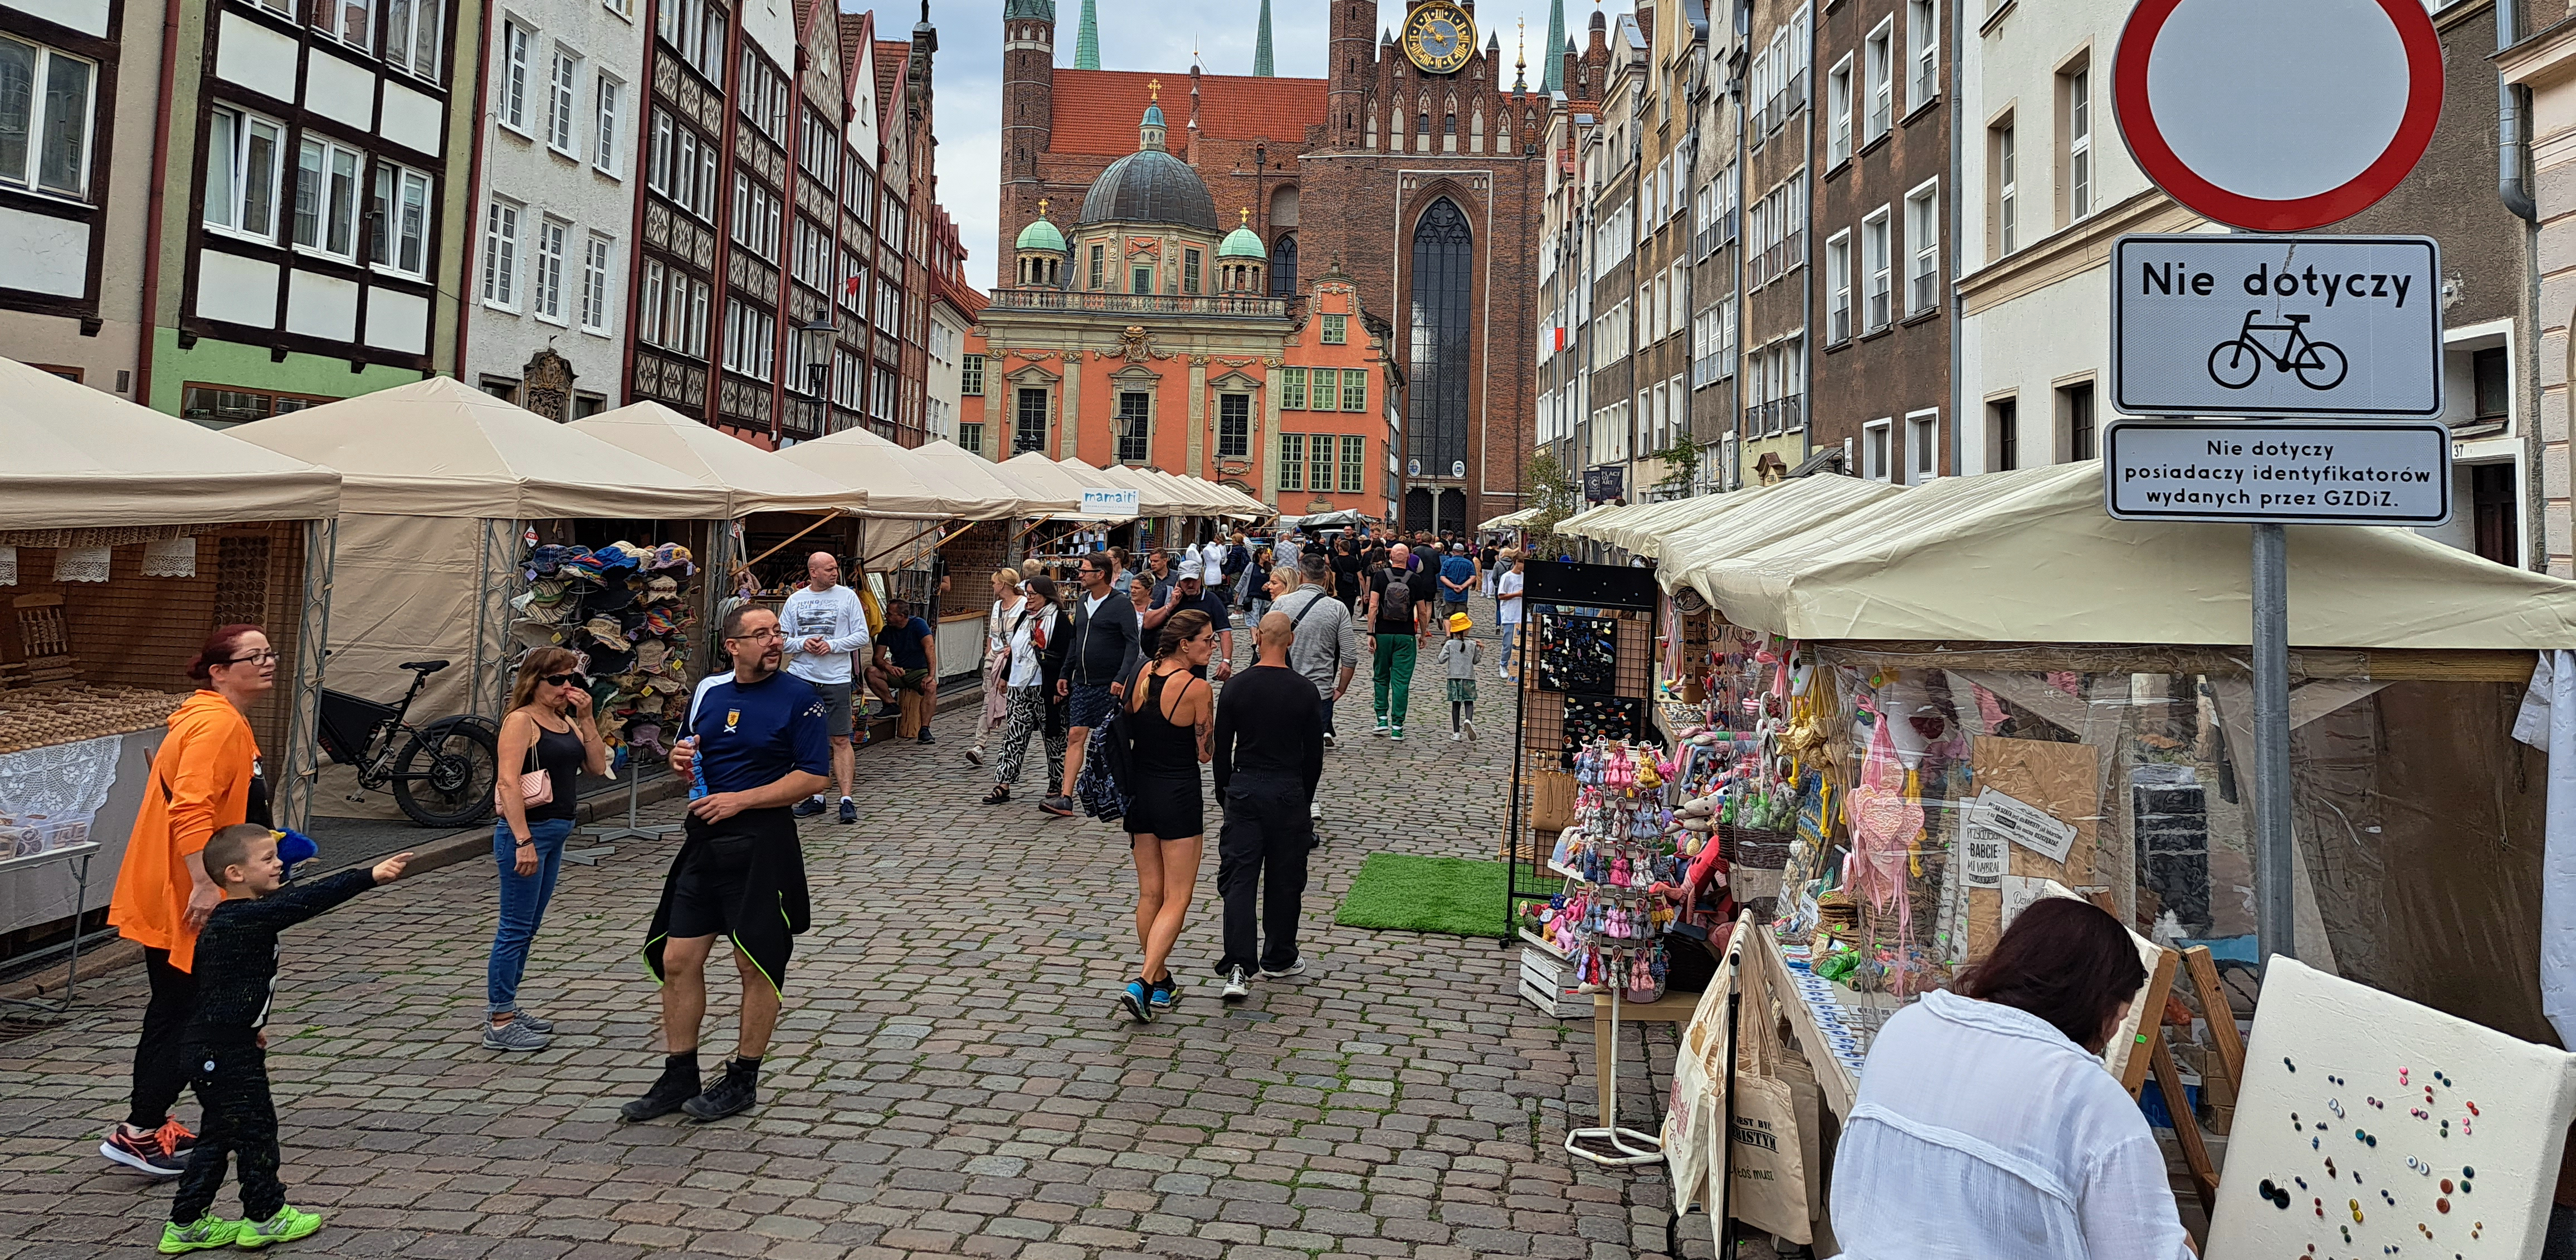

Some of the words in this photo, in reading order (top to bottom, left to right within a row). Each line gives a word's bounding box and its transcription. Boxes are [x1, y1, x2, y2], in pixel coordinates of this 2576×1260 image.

[2143, 262, 2214, 296] Nie
[2244, 263, 2412, 308] dotyczy
[2208, 440, 2242, 455] Nie
[2252, 441, 2334, 461] dotyczy
[2454, 444, 2463, 457] 37
[2125, 464, 2243, 484] posiadaczy
[2253, 465, 2430, 485] identyfikatorów
[1085, 490, 1136, 503] mamaiti
[2146, 488, 2250, 508] wydanych
[2261, 494, 2316, 508] przez
[2324, 490, 2398, 507] GZDiZ.
[2024, 819, 2040, 830] KOBIETY
[1970, 842, 1998, 859] BABCIE
[1968, 859, 1975, 871] MI
[1758, 1120, 1772, 1131] BYĆ
[1732, 1127, 1777, 1151] EBISTYM
[1753, 1169, 1774, 1181] musi
